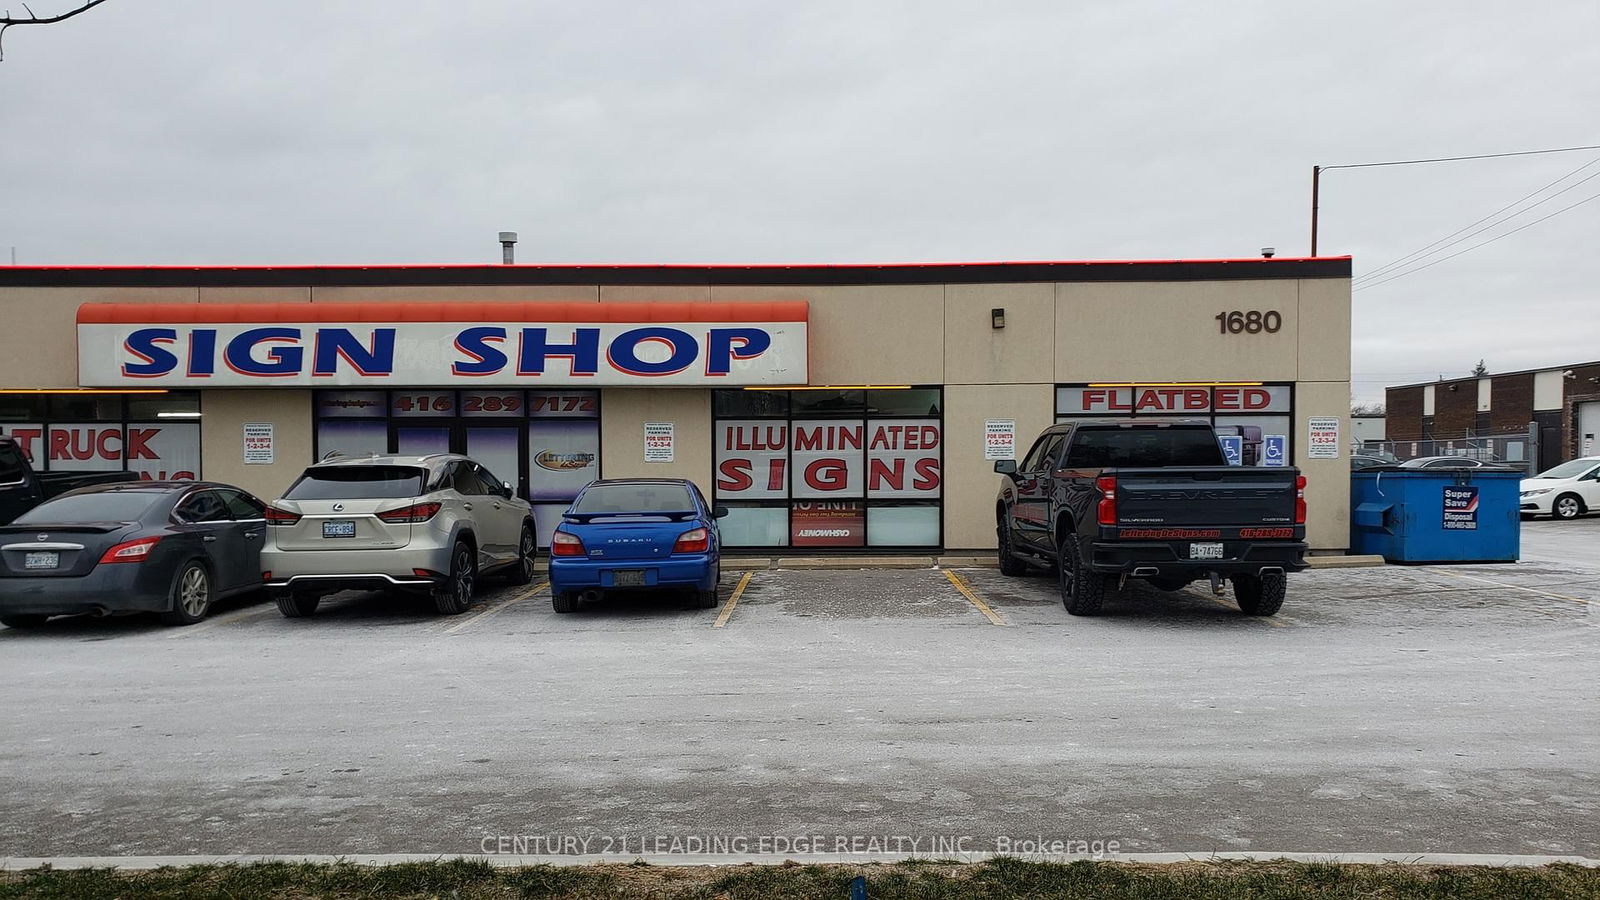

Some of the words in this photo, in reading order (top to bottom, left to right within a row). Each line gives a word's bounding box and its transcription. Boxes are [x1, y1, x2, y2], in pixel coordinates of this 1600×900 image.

[1215, 310, 1282, 334] 1680
[121, 327, 397, 378] SIGN
[451, 326, 771, 377] SHOP
[395, 396, 453, 411] 416
[463, 396, 521, 411] 289
[530, 396, 597, 411] 7172
[1082, 389, 1271, 411] FLATBED
[11, 428, 162, 461] TRUCK
[726, 425, 939, 451] ILLUMINATED
[717, 457, 940, 491] SIGNS
[1444, 489, 1472, 500] Super
[1444, 499, 1468, 507] Save
[1444, 512, 1473, 522] Disposal
